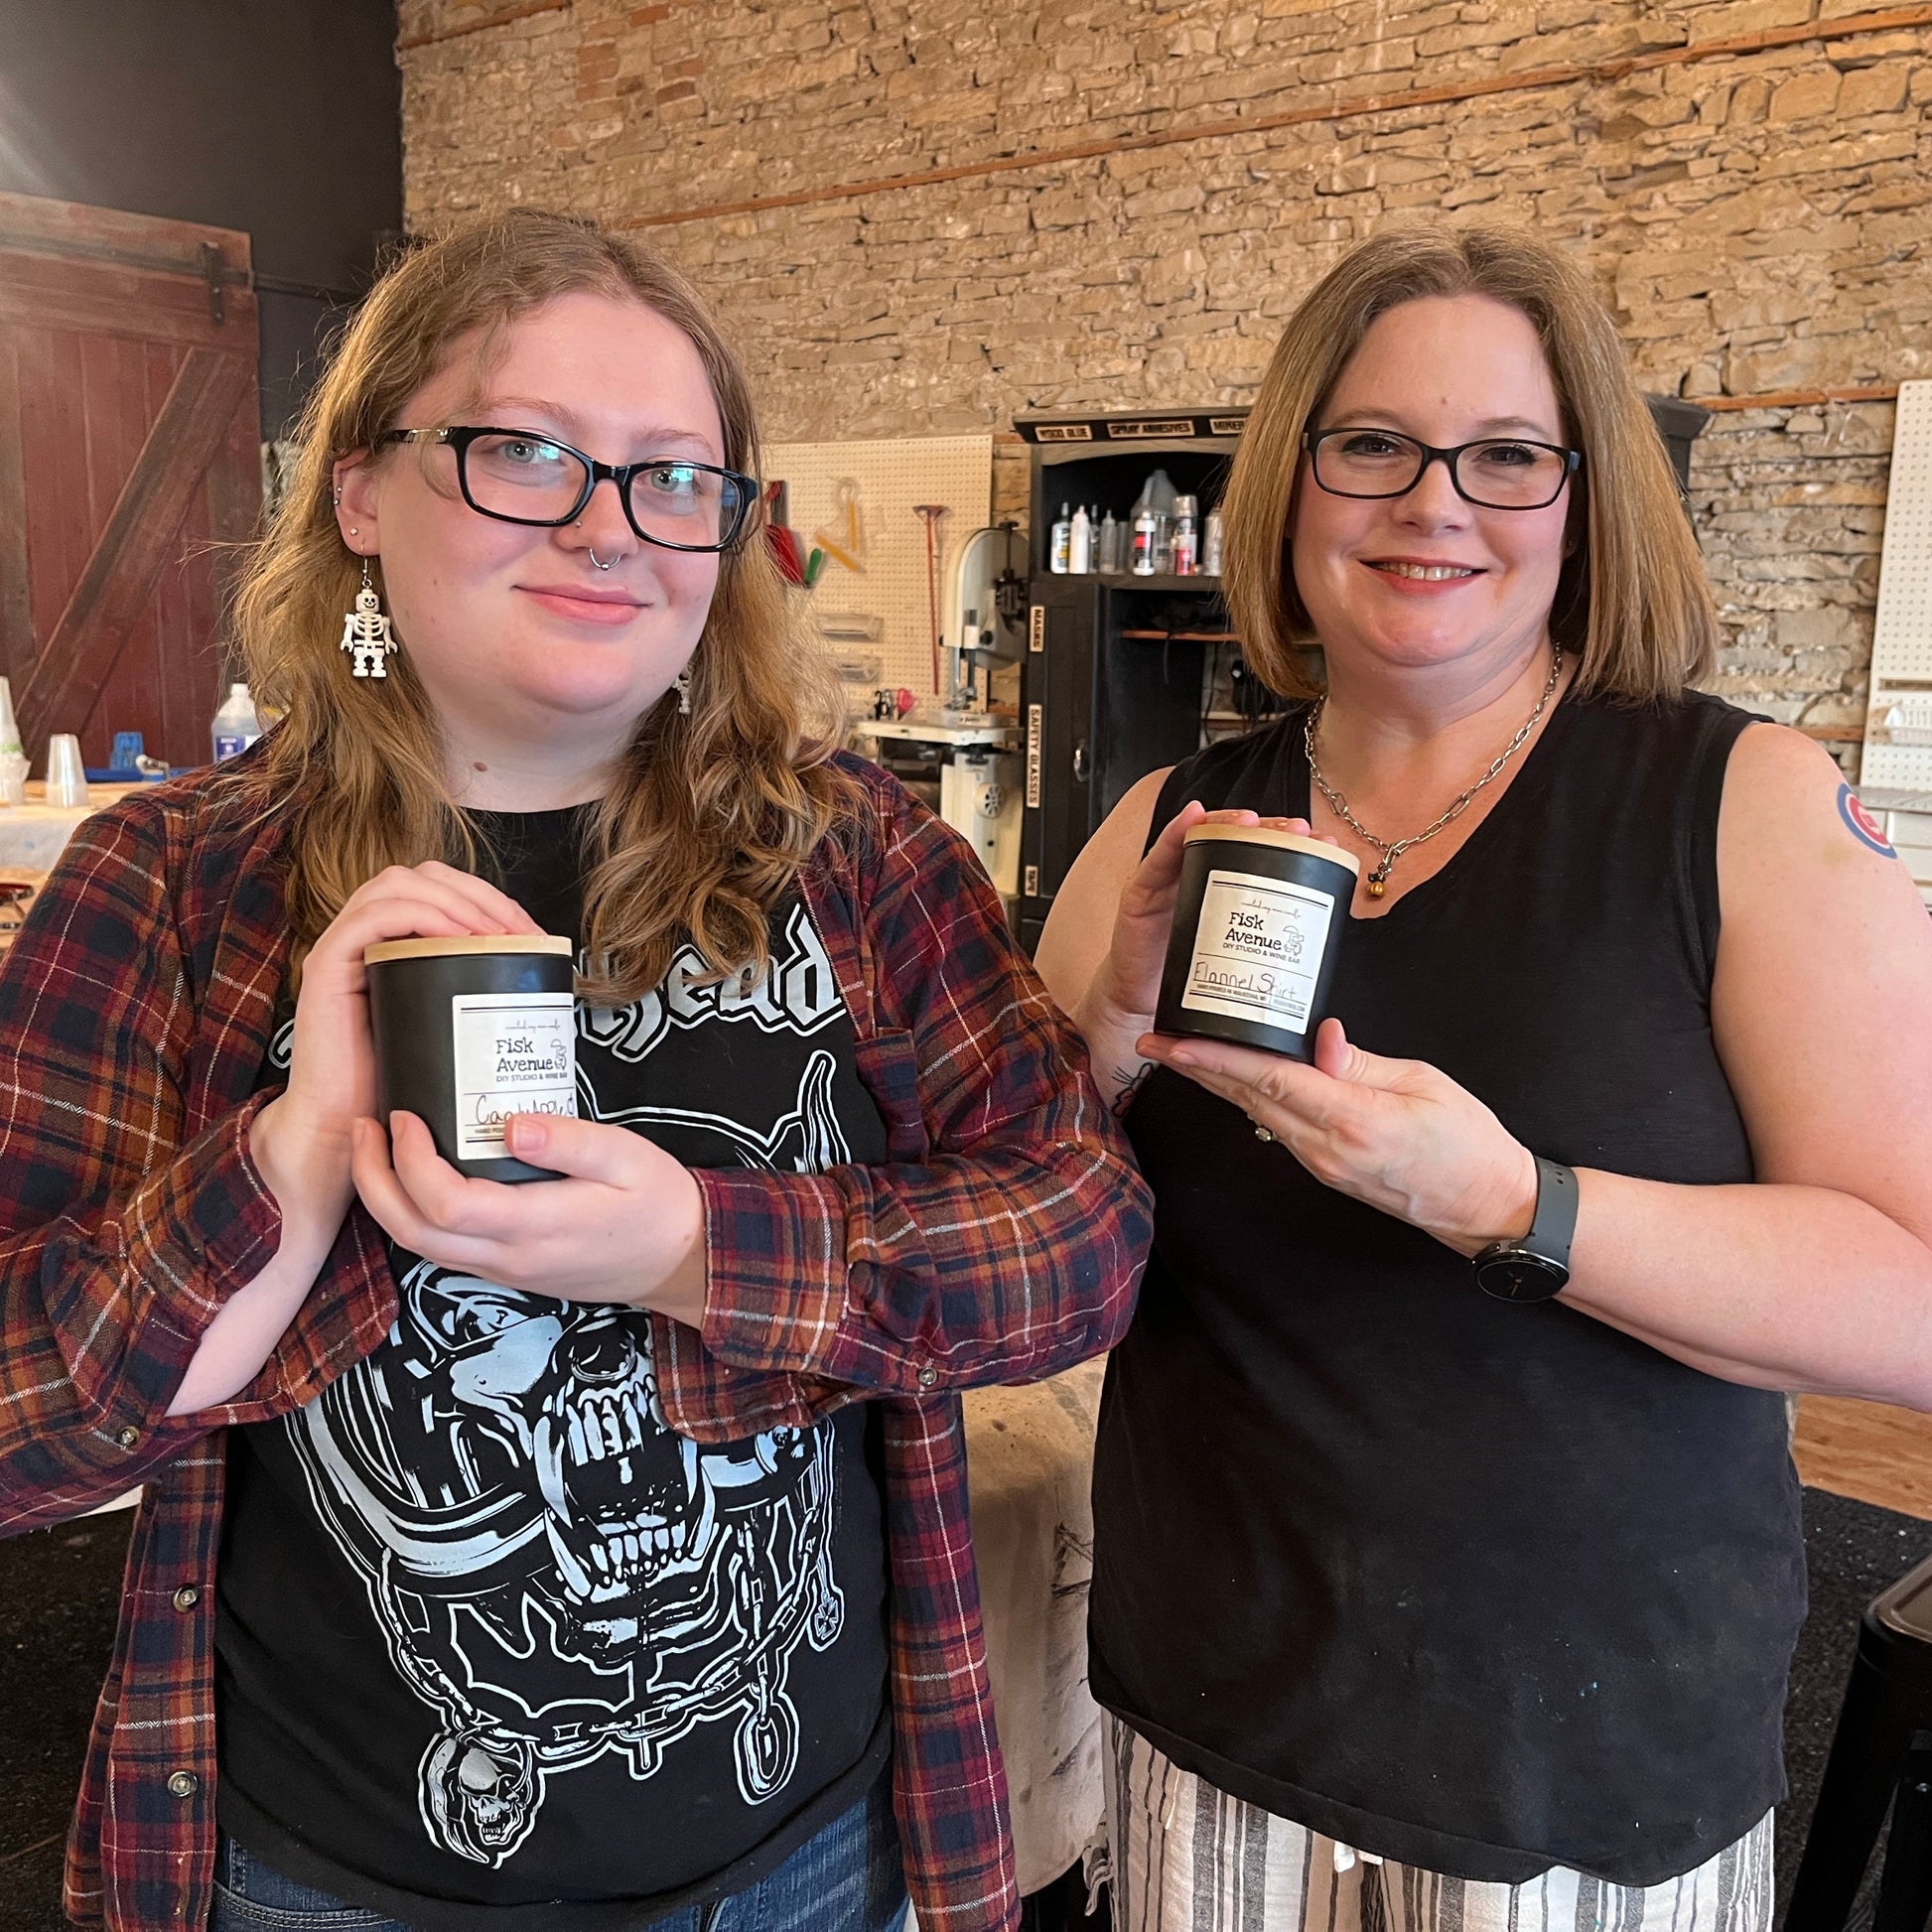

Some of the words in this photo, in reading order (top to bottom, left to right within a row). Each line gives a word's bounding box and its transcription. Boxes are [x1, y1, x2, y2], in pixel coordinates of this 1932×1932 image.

[1110, 424, 1140, 435] SPRAY
[1142, 422, 1191, 434] ADHESIVES
[1033, 609, 1041, 648] MASKS
[1031, 708, 1039, 750] SAFETY
[1029, 754, 1038, 804] GLASSES
[1228, 911, 1265, 930] Fisk
[1224, 927, 1282, 950] Avenue
[1235, 943, 1262, 955] STUDIO
[1269, 952, 1287, 961] WINE
[1193, 961, 1254, 990] Flannel
[1256, 973, 1297, 999] Shirt
[495, 1037, 534, 1054] Fisk
[496, 1057, 554, 1072] Avenue
[511, 1073, 537, 1082] STUDIO
